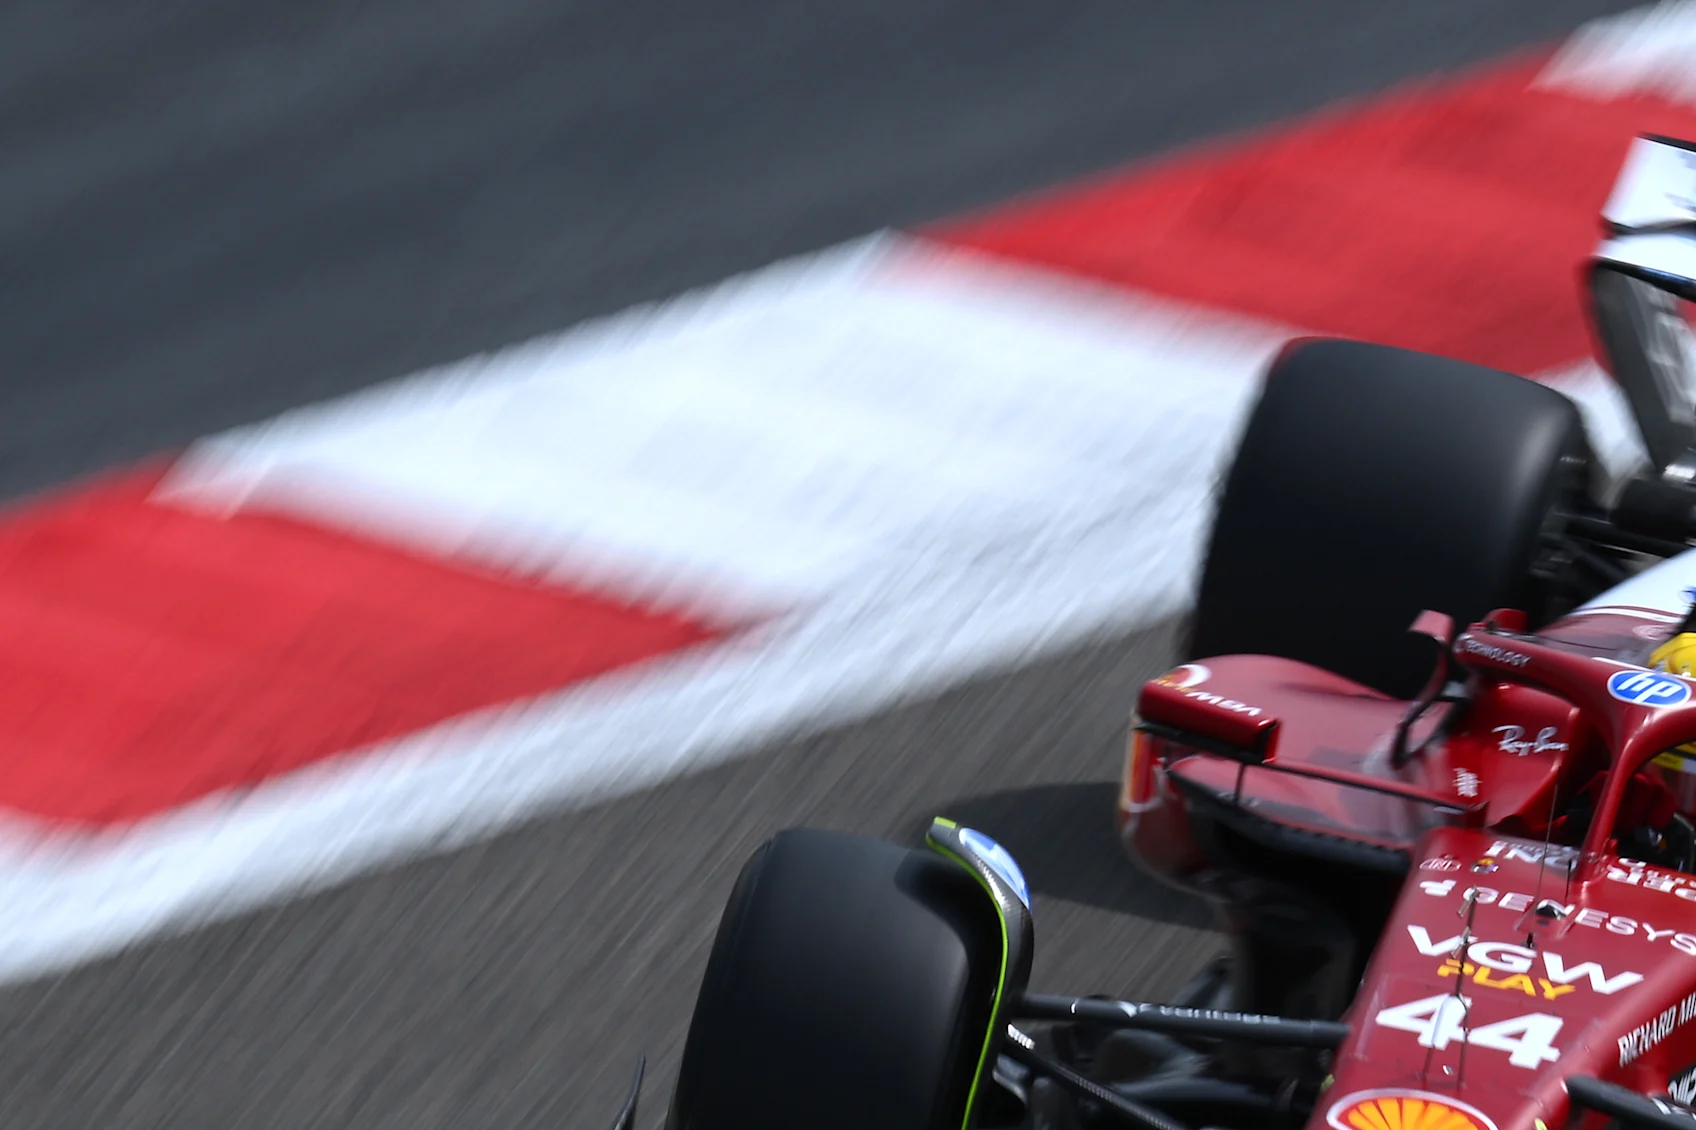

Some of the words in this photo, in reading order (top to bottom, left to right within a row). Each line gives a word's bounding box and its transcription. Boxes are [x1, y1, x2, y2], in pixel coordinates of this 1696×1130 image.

[1617, 671, 1684, 704] hp
[1491, 724, 1570, 757] Ray-Ban
[1406, 924, 1644, 996] VGW
[1437, 958, 1577, 1002] PLAY
[1376, 992, 1564, 1071] 44
[1617, 1012, 1676, 1068] RICHARD
